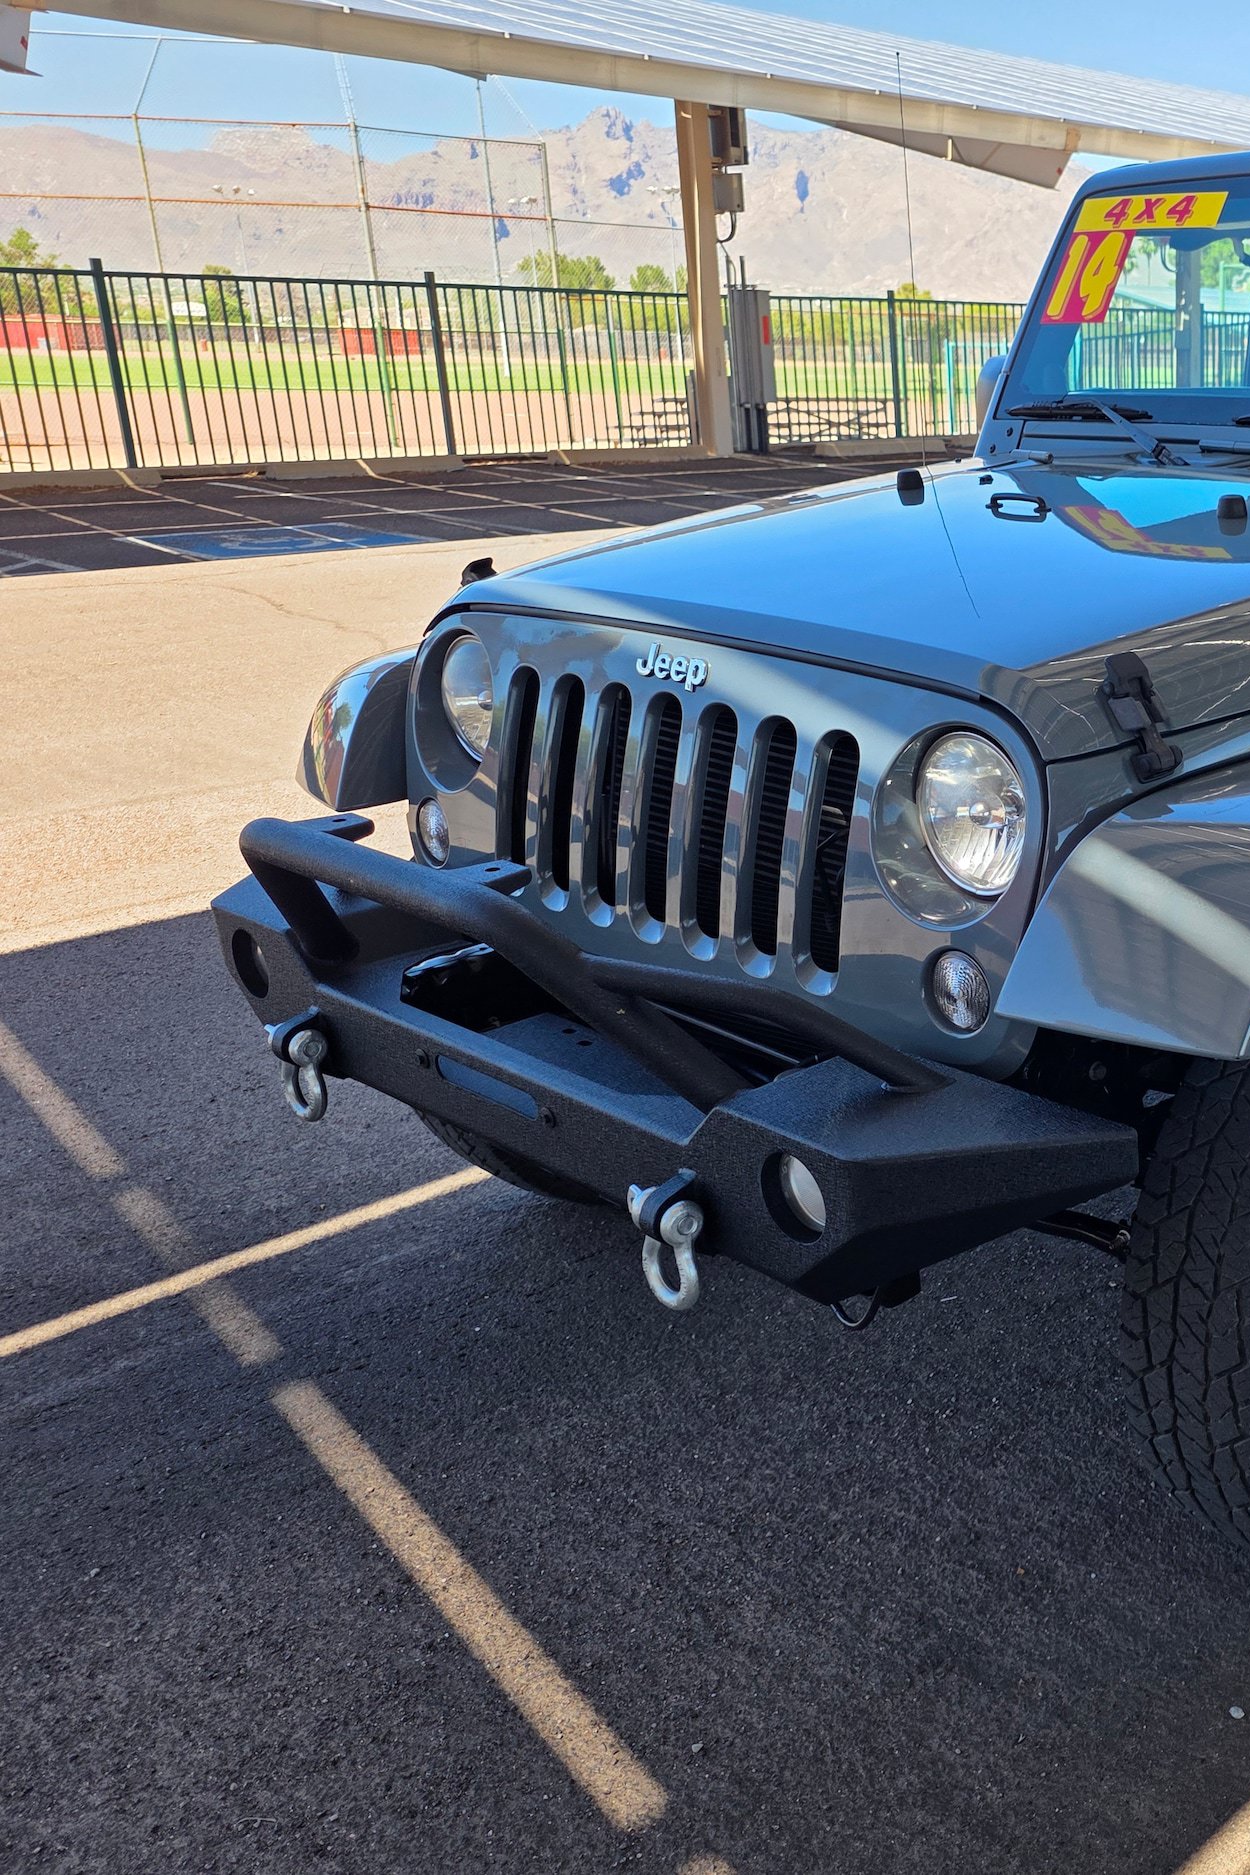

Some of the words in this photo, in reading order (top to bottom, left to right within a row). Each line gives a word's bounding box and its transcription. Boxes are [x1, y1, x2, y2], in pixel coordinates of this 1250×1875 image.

[1103, 194, 1198, 228] 4X4
[1046, 231, 1128, 320] 14
[635, 642, 709, 693] Jeep
